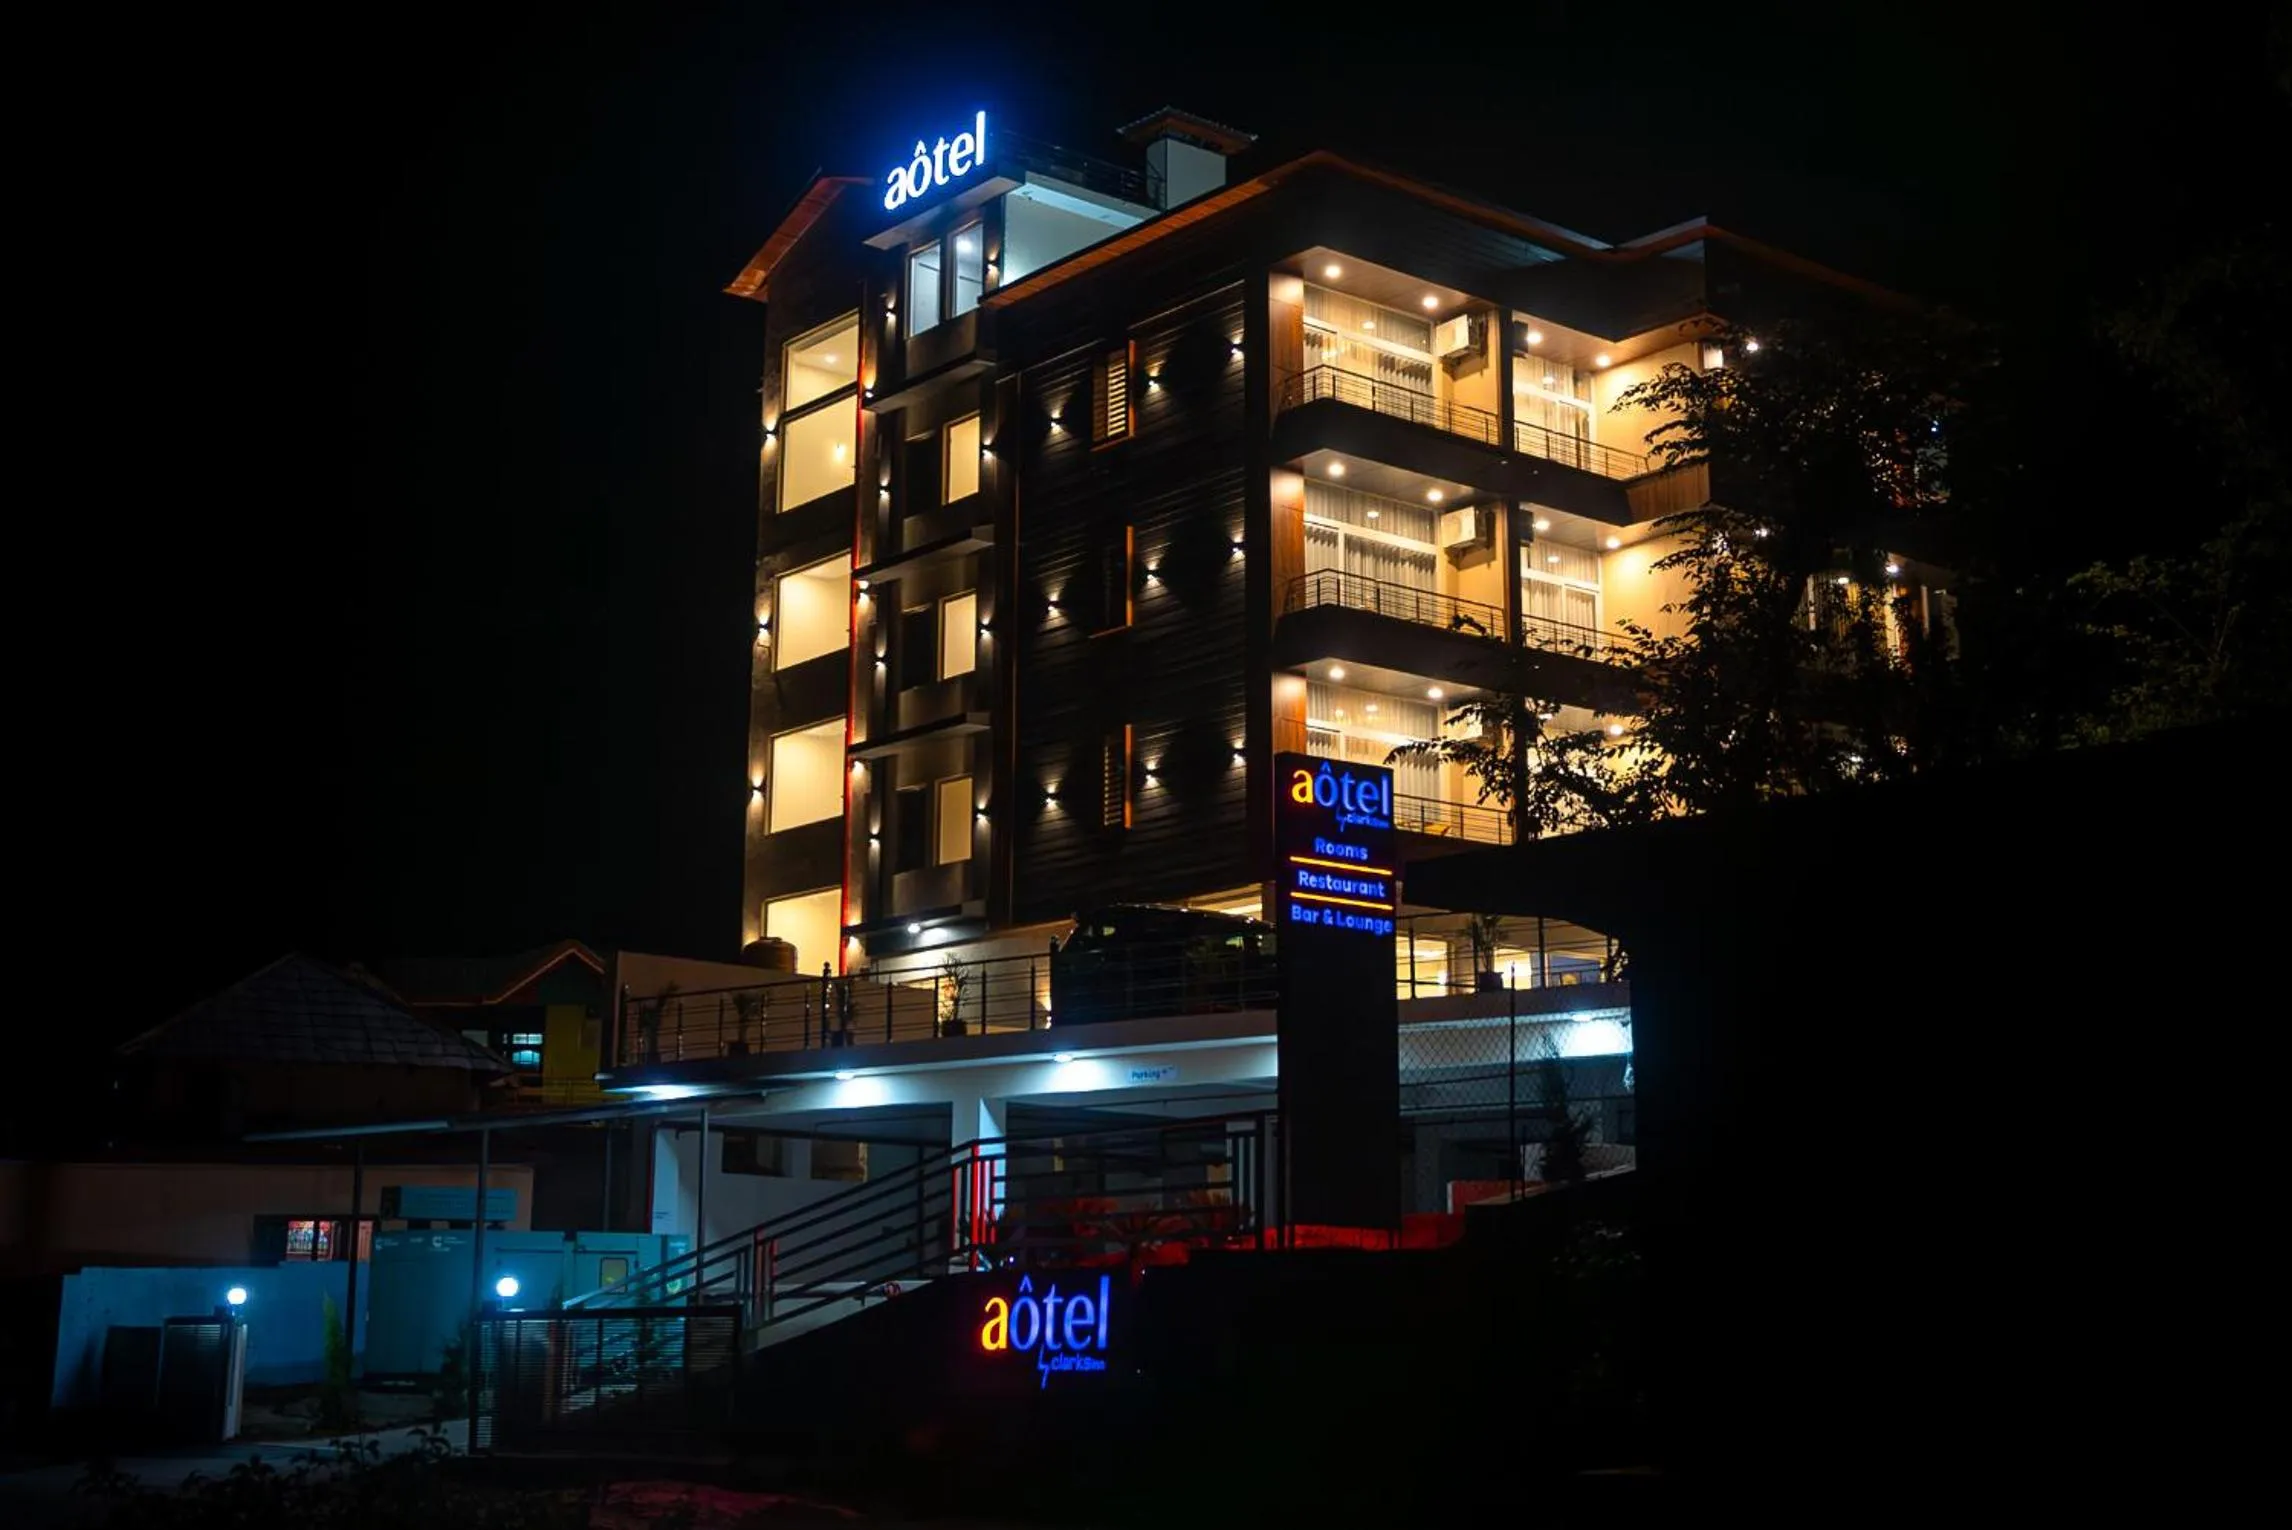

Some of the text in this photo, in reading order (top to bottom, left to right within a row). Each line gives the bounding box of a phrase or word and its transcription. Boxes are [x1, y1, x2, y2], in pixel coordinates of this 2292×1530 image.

[884, 110, 986, 211] aôtel
[1291, 760, 1389, 817] aôtel
[1314, 837, 1369, 861] Rooms
[1298, 870, 1386, 898] Restaurant
[1291, 904, 1394, 936] Bar & Lounge
[981, 1273, 1111, 1351] aôtel
